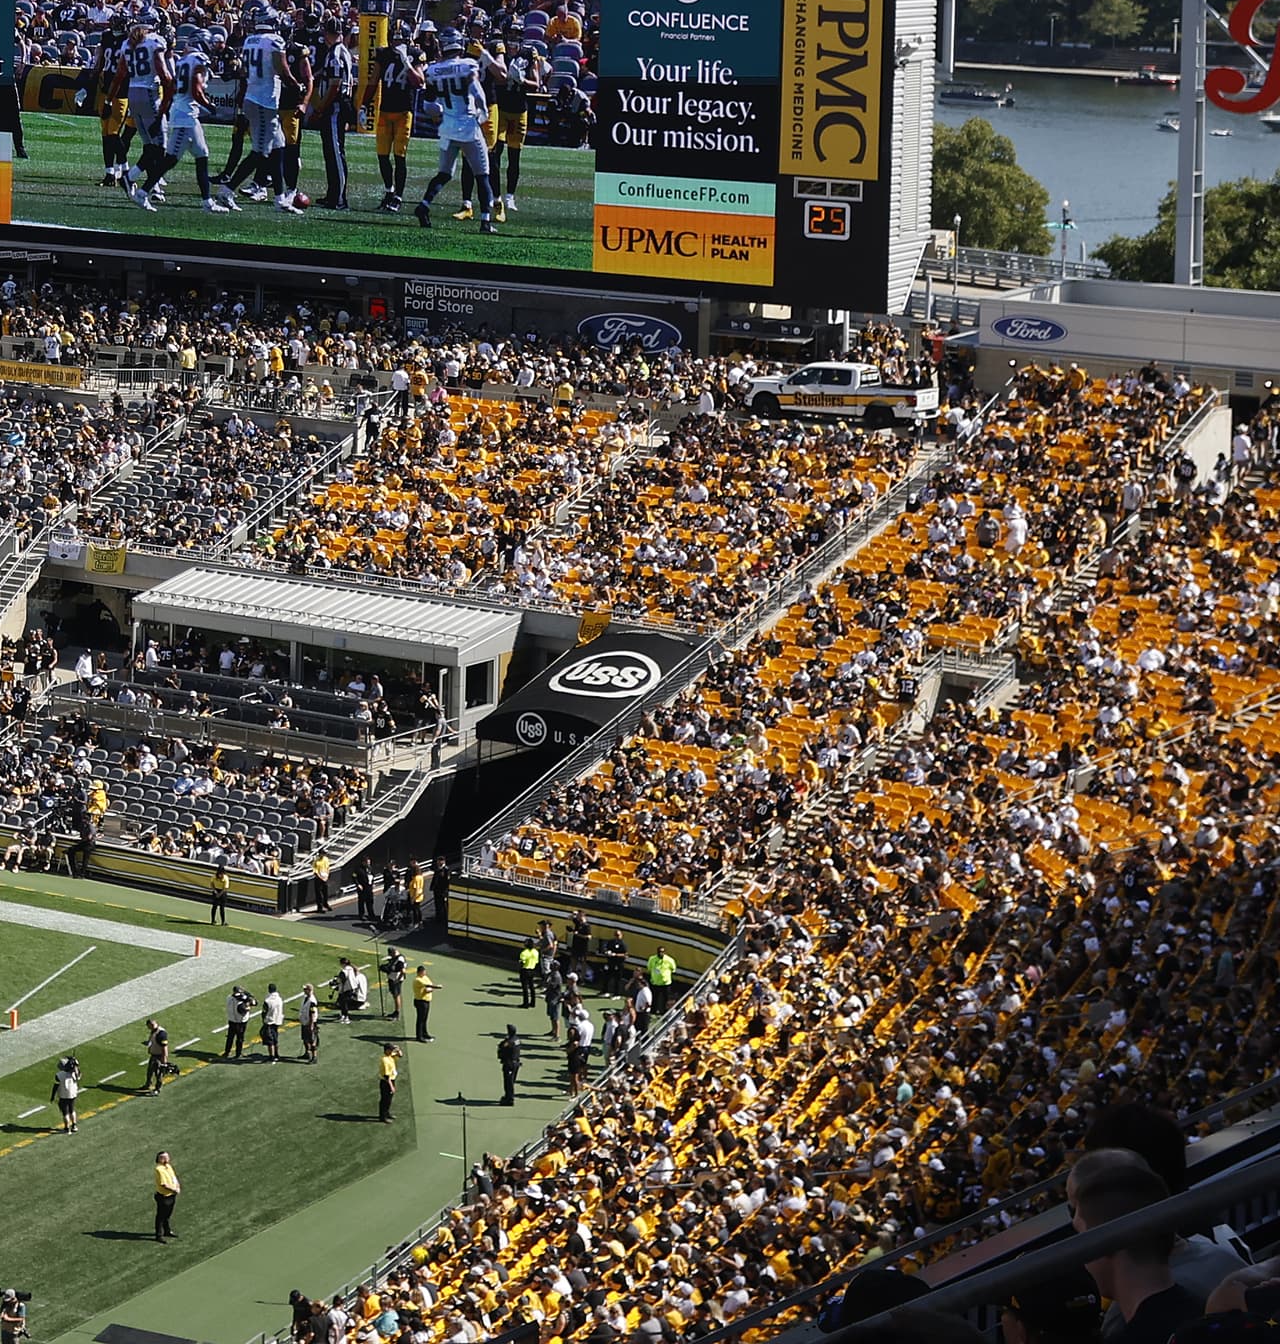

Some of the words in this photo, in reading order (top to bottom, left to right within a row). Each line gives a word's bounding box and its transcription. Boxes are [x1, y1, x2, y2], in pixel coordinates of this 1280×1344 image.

[627, 10, 750, 33] CONFLUENCE
[660, 31, 689, 41] Financial
[690, 32, 715, 42] Partners
[636, 56, 694, 82] Your
[697, 58, 739, 86] life.
[616, 89, 672, 115] Your
[677, 93, 757, 122] legacy.
[791, 84, 805, 162] MEDICINE
[611, 120, 657, 146] Our
[662, 123, 761, 154] mission.
[617, 180, 751, 206] ConfluenceFP.com
[809, 206, 846, 235] 25
[600, 225, 700, 258] UPMC
[711, 233, 768, 250] HEALTH
[711, 246, 750, 262] PLAN
[404, 281, 500, 303] Neighborhood
[404, 296, 436, 312] Ford
[438, 299, 474, 315] Store
[1006, 317, 1053, 342] Ford
[793, 391, 844, 407] Steelers
[566, 661, 648, 689] USS
[520, 719, 543, 739] USS
